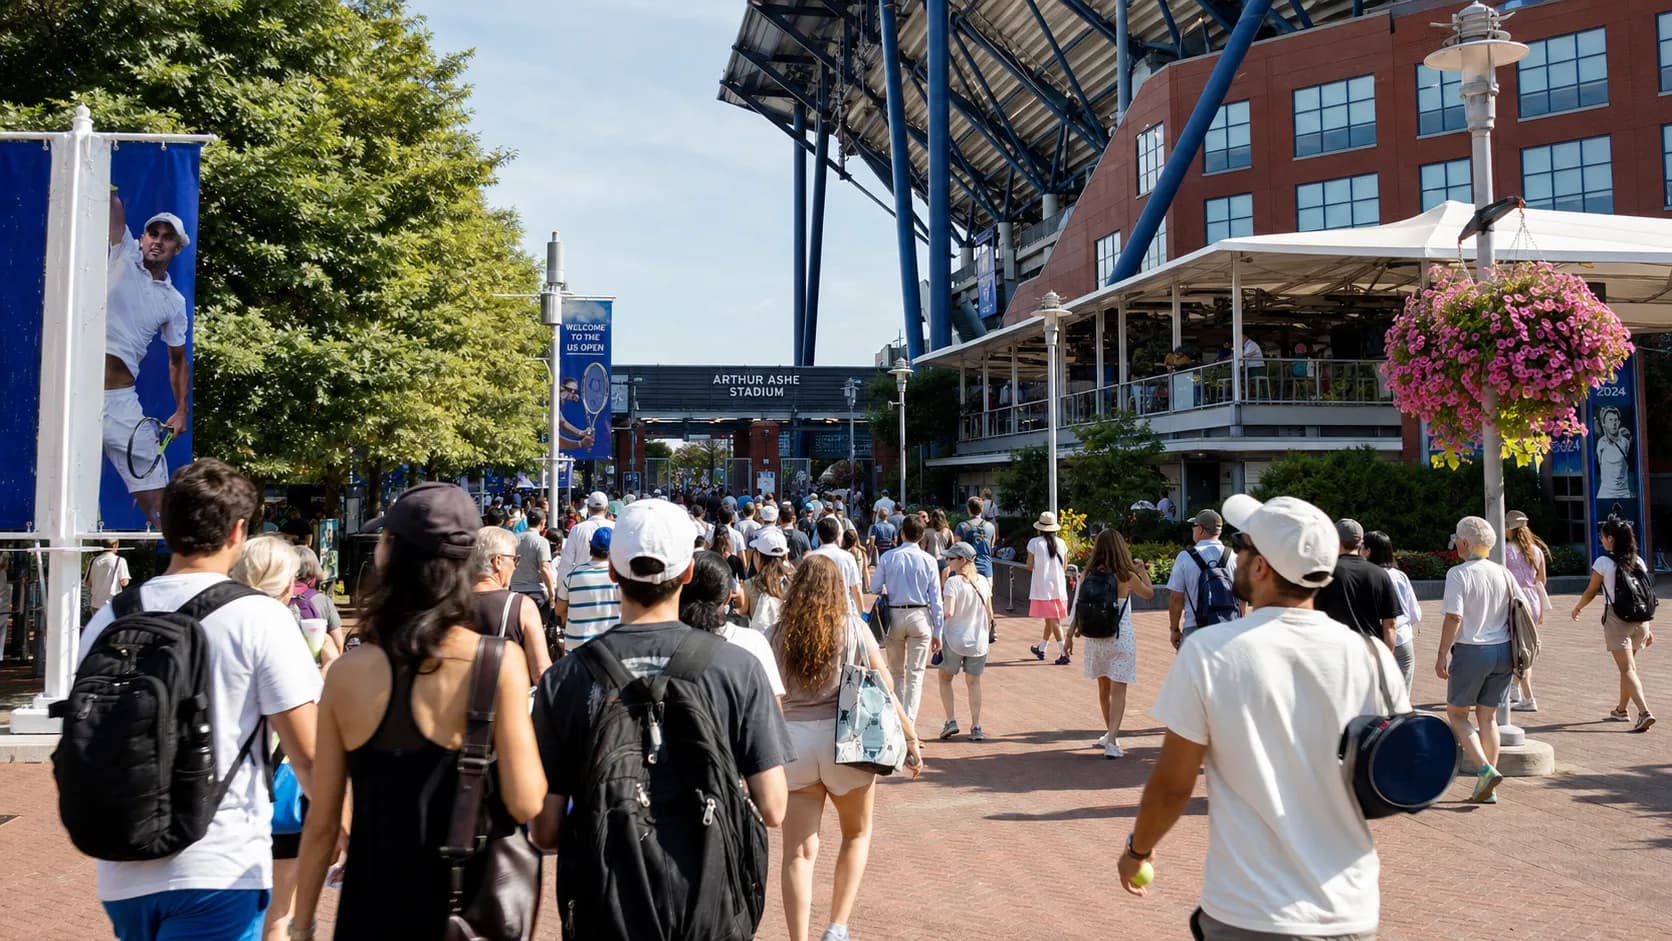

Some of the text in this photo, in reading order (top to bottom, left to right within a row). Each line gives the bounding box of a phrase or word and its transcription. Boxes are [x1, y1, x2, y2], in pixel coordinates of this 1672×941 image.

[571, 333, 601, 341] TO THE
[567, 343, 604, 351] US OPEN
[713, 374, 800, 385] ARTHUR ASHE
[729, 386, 784, 396] STADIUM
[1597, 386, 1626, 396] 2024
